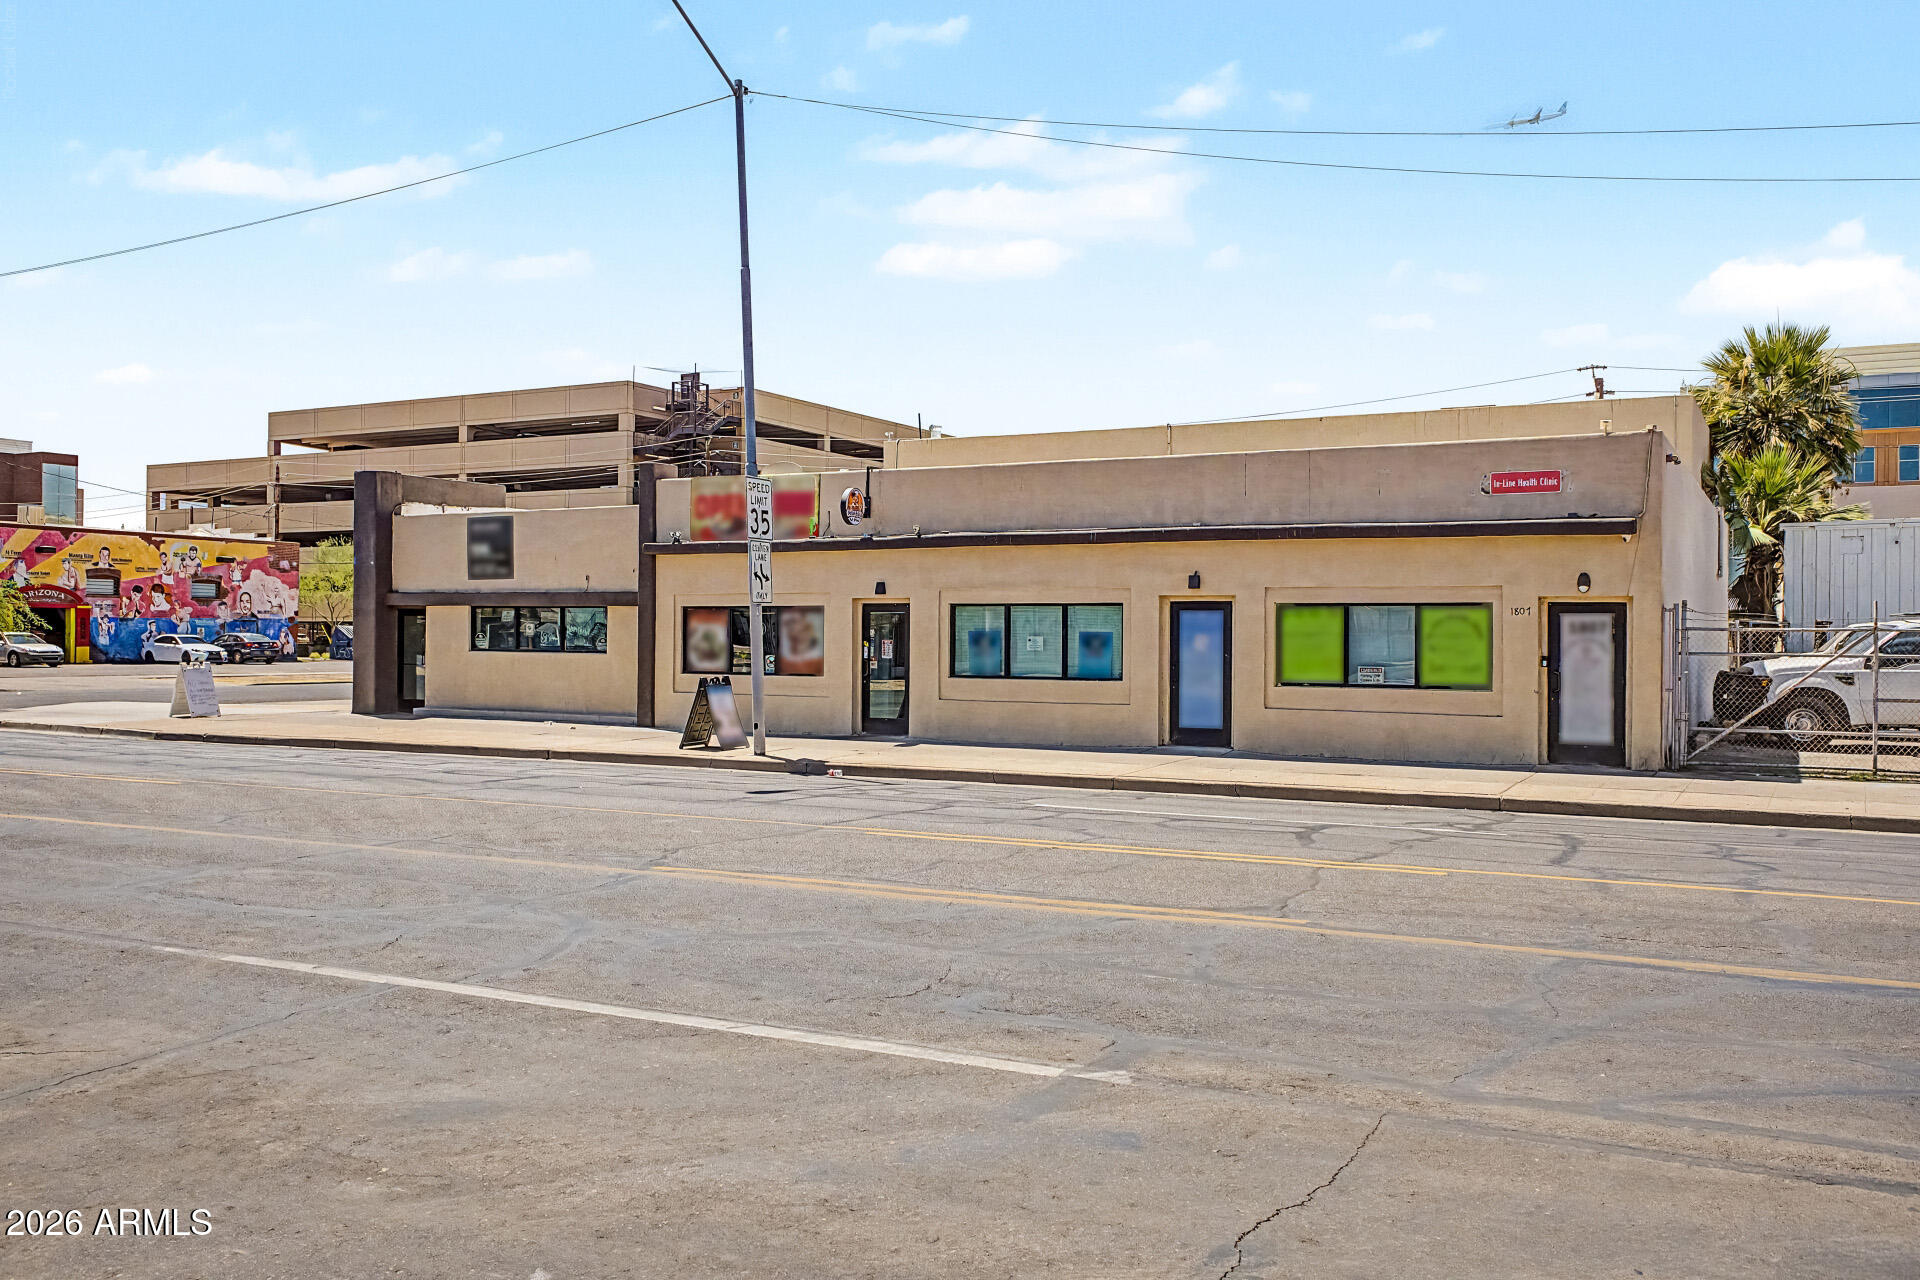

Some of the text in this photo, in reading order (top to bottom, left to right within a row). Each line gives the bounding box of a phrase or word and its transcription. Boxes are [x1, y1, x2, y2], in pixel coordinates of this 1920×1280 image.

[748, 481, 770, 494] SPEED
[1493, 476, 1558, 488] In-Line Health Clinic
[750, 494, 768, 507] LIMIT
[750, 507, 770, 536] 35
[755, 552, 767, 562] LANE
[755, 591, 768, 600] ONLY
[1510, 606, 1531, 616] 1807
